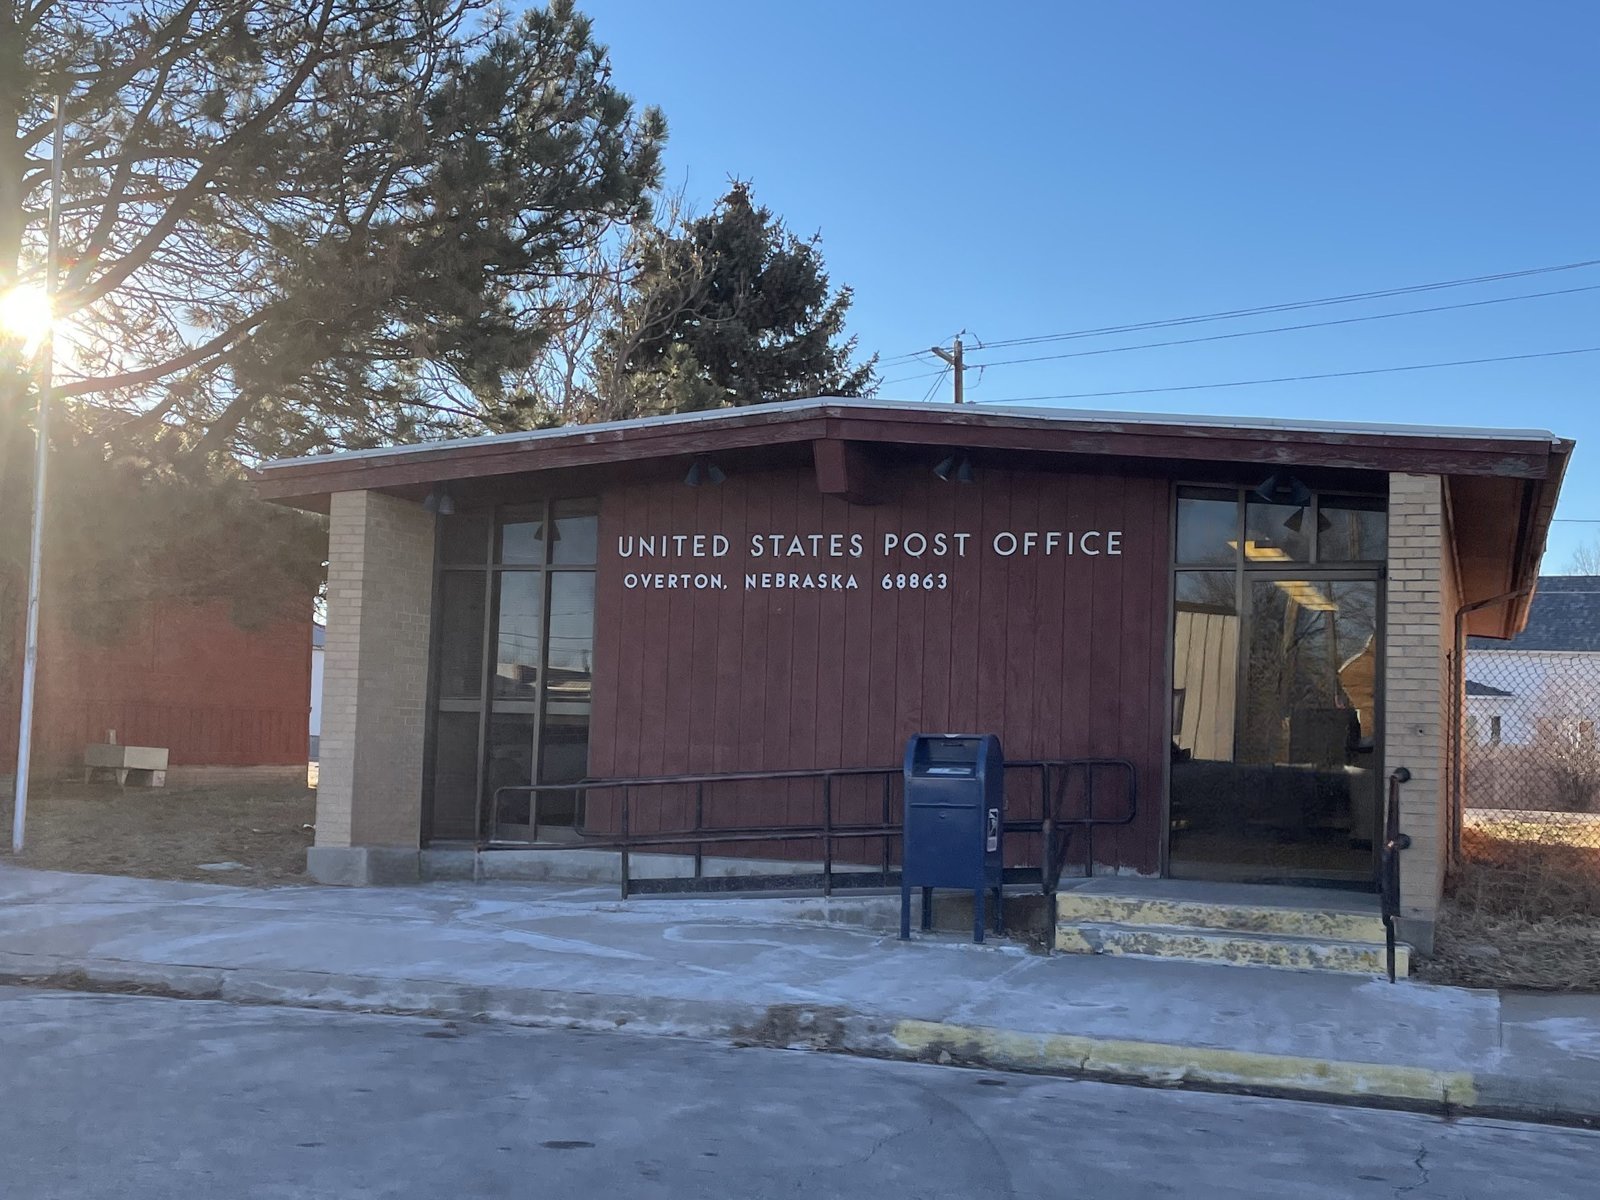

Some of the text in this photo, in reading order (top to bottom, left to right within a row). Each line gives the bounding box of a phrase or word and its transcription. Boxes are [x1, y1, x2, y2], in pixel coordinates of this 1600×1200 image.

[617, 531, 1123, 558] UNITED STATES POST OFFICE
[623, 572, 948, 590] OVERTON, NEBRASKA 68863
